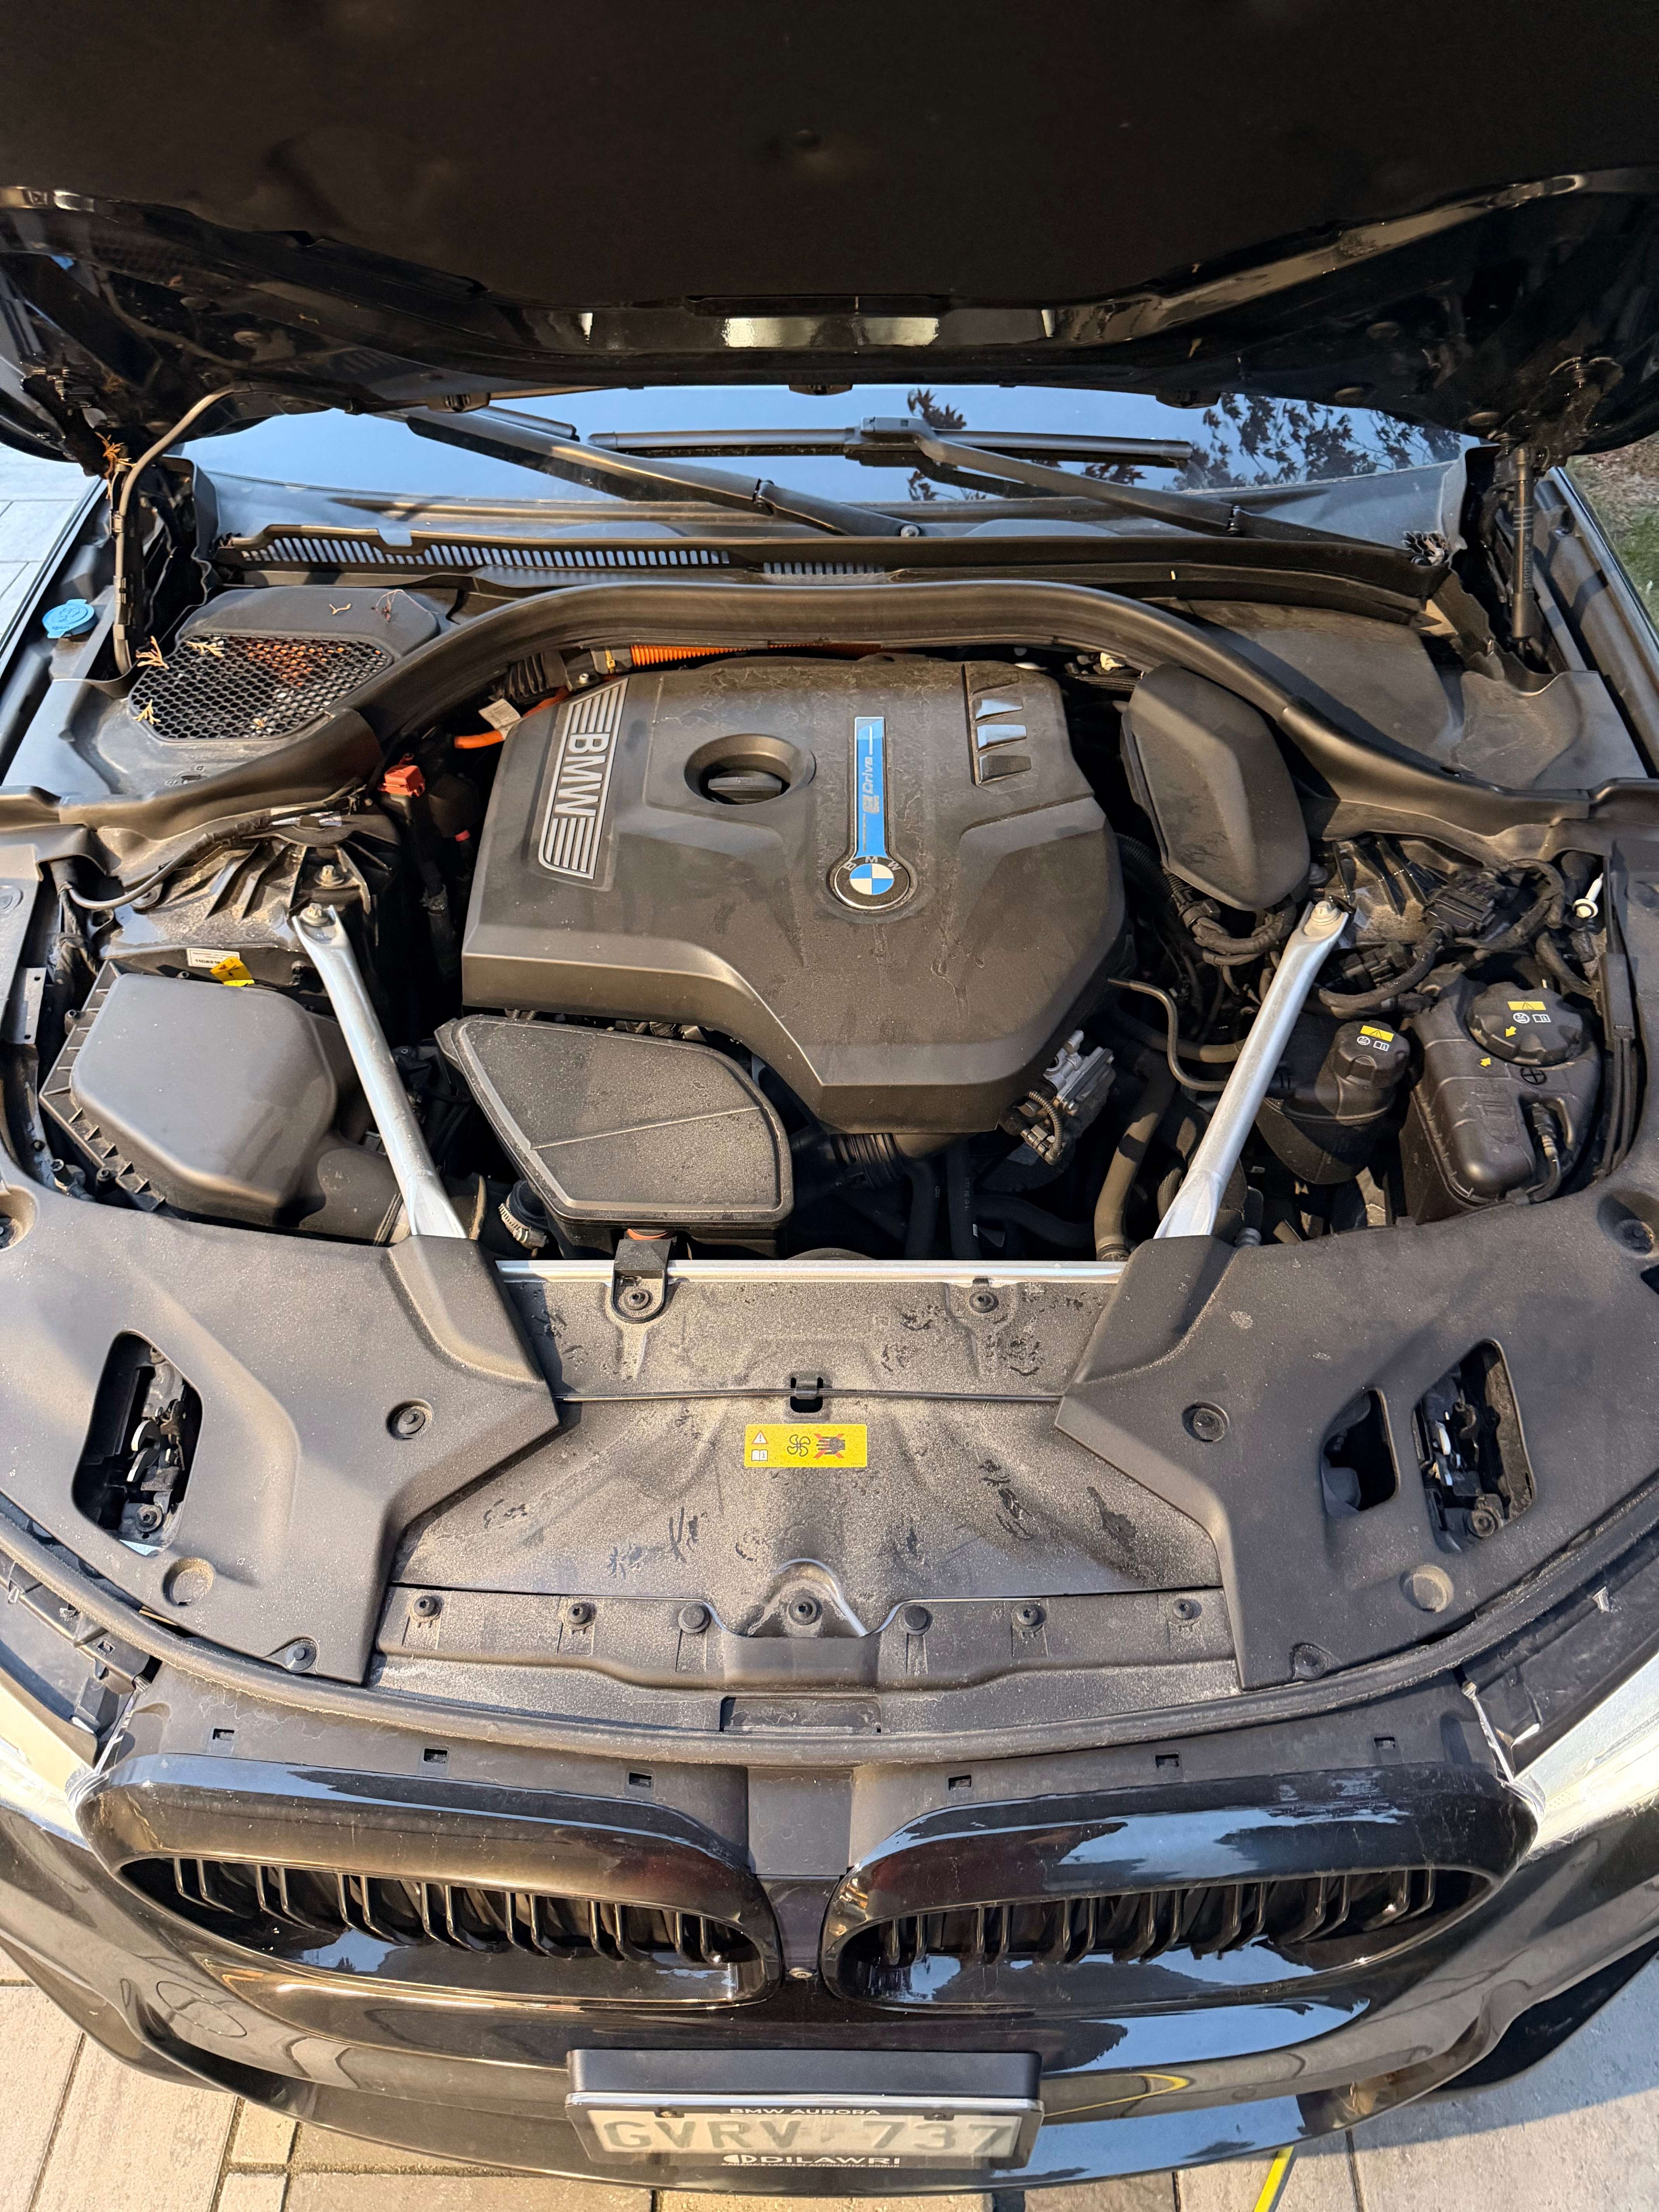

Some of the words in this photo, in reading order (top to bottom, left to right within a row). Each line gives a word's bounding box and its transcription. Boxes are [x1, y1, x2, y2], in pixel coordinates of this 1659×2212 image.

[555, 733, 610, 816] BMW
[842, 856, 902, 871] BMW
[603, 2120, 802, 2148] GVRV
[863, 2121, 1012, 2154] 737
[761, 2156, 900, 2164] DILAWRI
